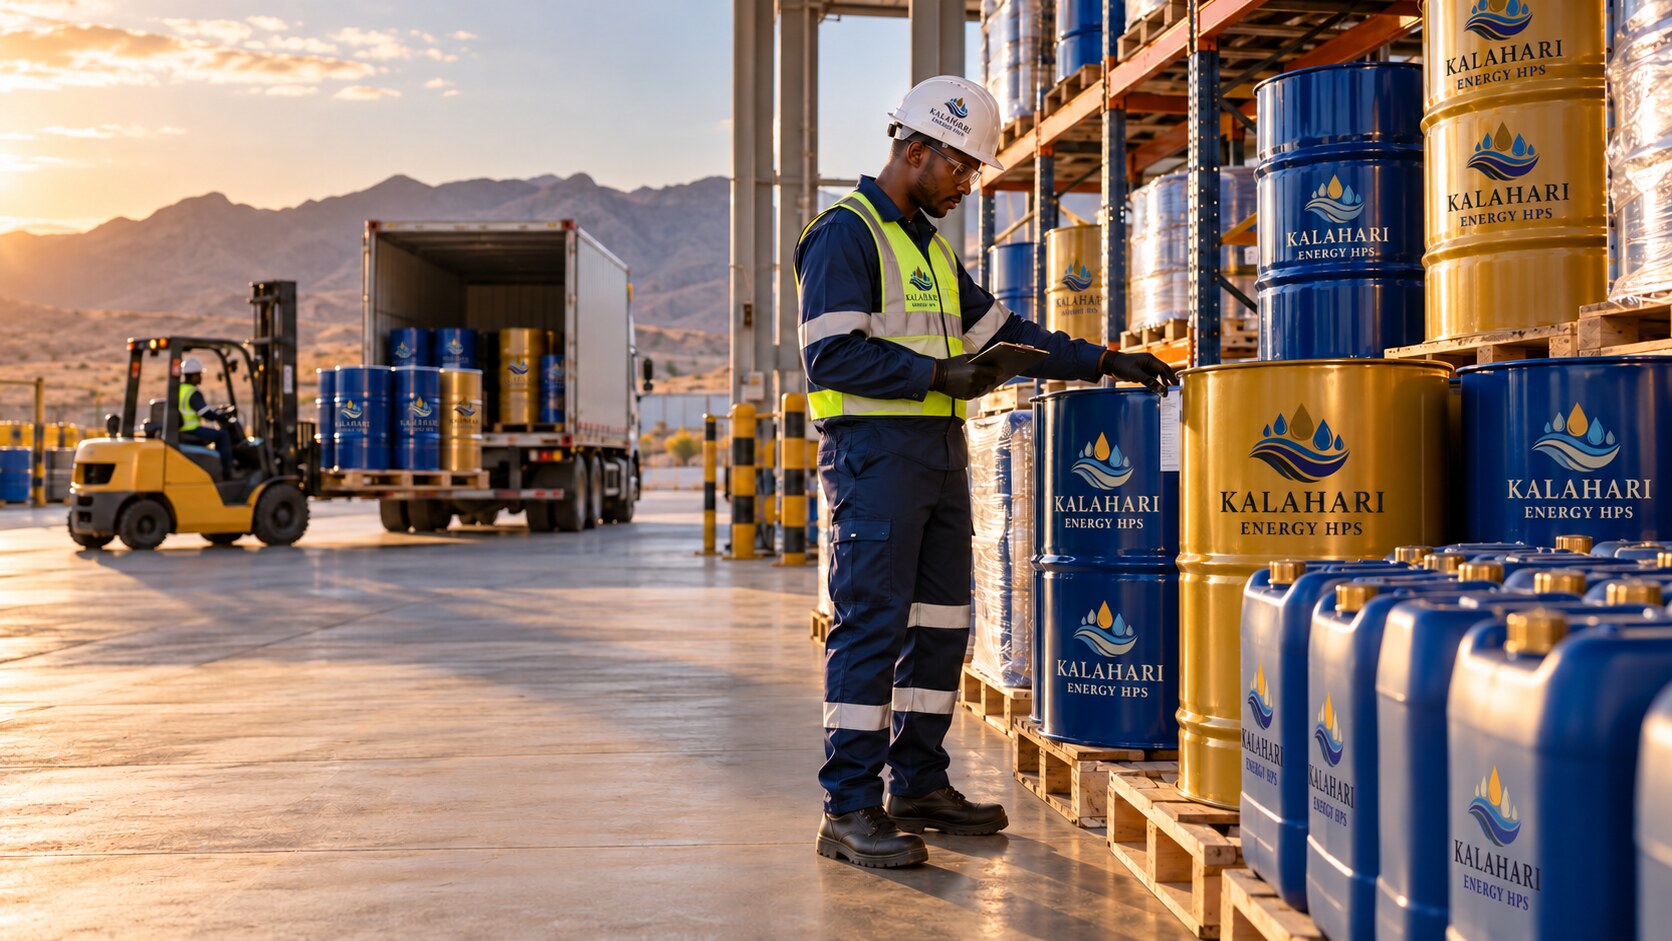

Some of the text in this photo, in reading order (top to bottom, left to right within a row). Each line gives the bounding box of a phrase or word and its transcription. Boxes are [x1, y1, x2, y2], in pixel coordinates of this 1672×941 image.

[1446, 39, 1563, 76] KALAHARI
[1457, 64, 1546, 90] ENERGY HPS
[1447, 183, 1569, 213] KALAHARI
[1460, 207, 1553, 227] ENERGY HPS
[1286, 226, 1389, 248] KALAHARI
[1298, 247, 1375, 260] ENERGY HPS
[1507, 479, 1652, 500] KALAHARI
[1054, 495, 1160, 513] KALAHARI
[1220, 491, 1385, 514] KALAHARI
[1524, 506, 1633, 519] ENERGY HPS
[1065, 518, 1144, 530] ENERGY HPS
[1240, 522, 1363, 536] ENERGY HPS
[1057, 659, 1164, 682] KALAHARI
[1067, 683, 1148, 698] ENERGY HPS
[1242, 728, 1283, 767] KALAHARI
[1309, 764, 1354, 808] KALAHARI
[1454, 839, 1541, 892] KALAHARI
[1463, 874, 1529, 911] ENERGY HPS
